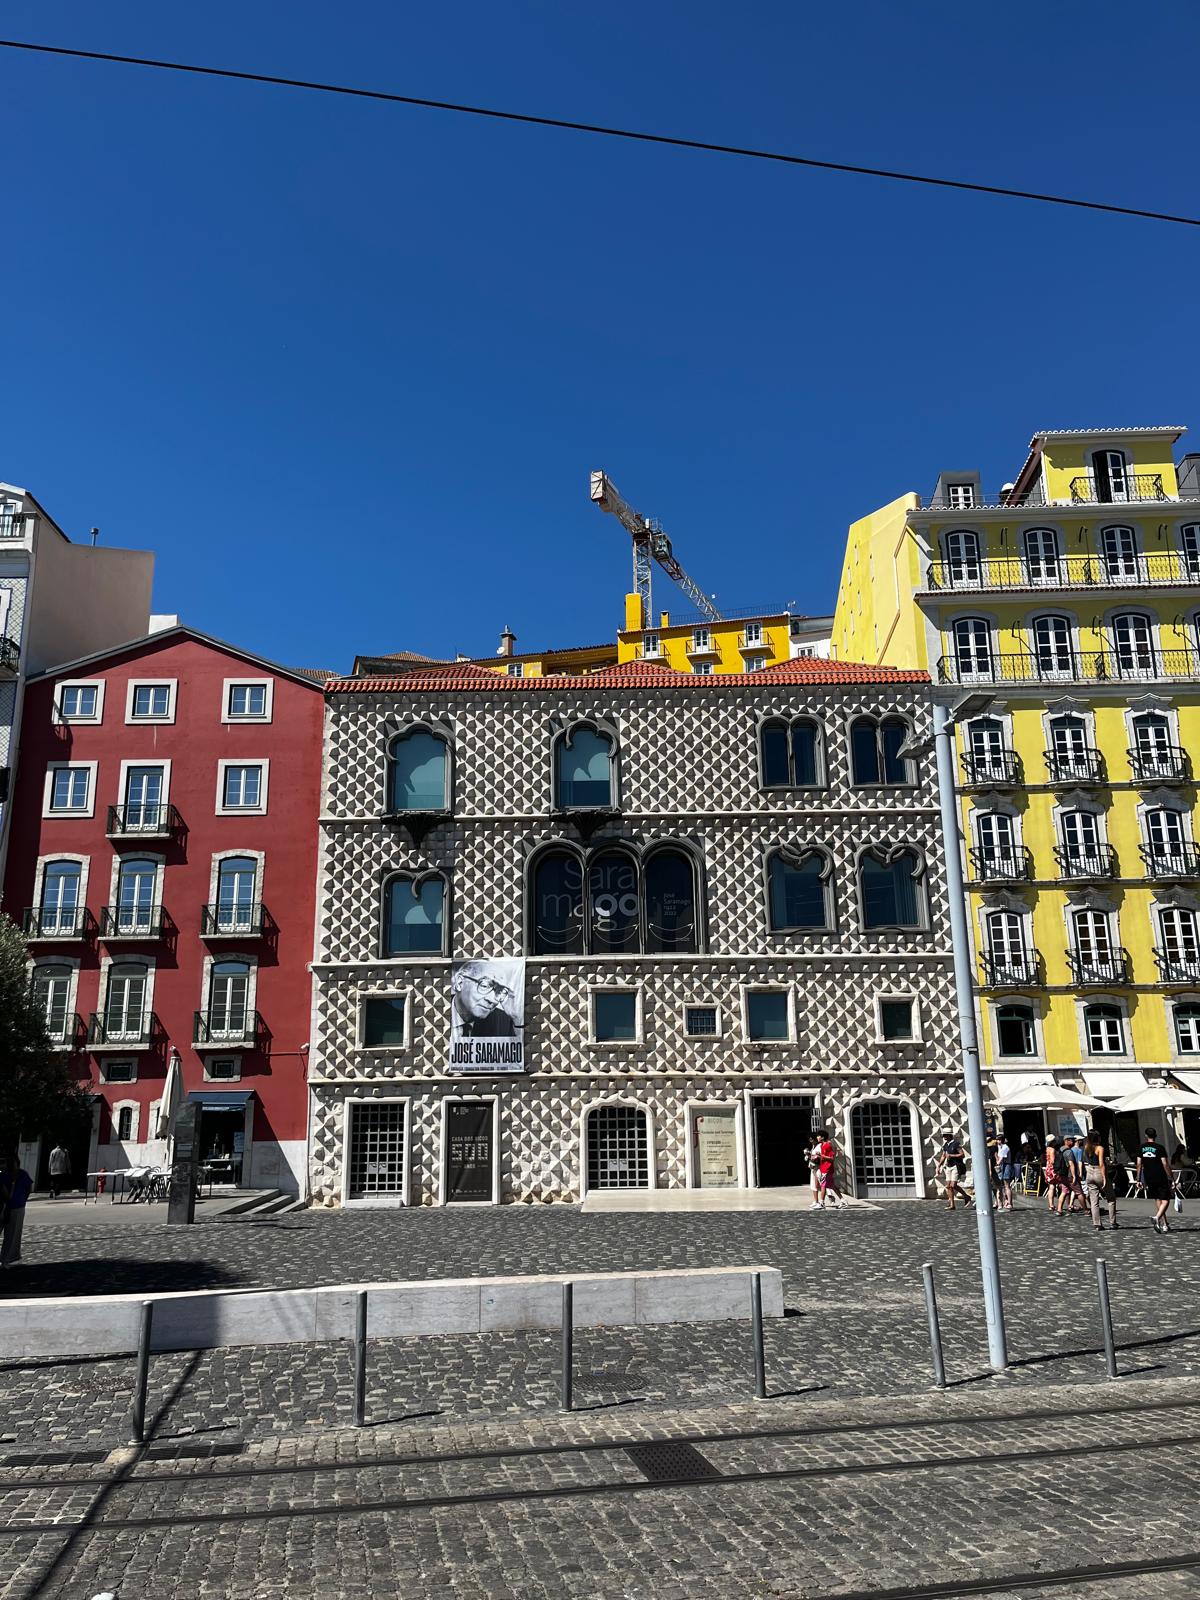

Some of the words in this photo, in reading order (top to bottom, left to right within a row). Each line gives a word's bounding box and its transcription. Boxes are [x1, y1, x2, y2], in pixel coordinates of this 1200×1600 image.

[564, 859, 635, 889] Sara
[543, 892, 640, 931] mago
[451, 1039, 473, 1064] JOSÉ
[476, 1042, 522, 1064] SARAMAGO
[452, 1143, 488, 1161] 500
